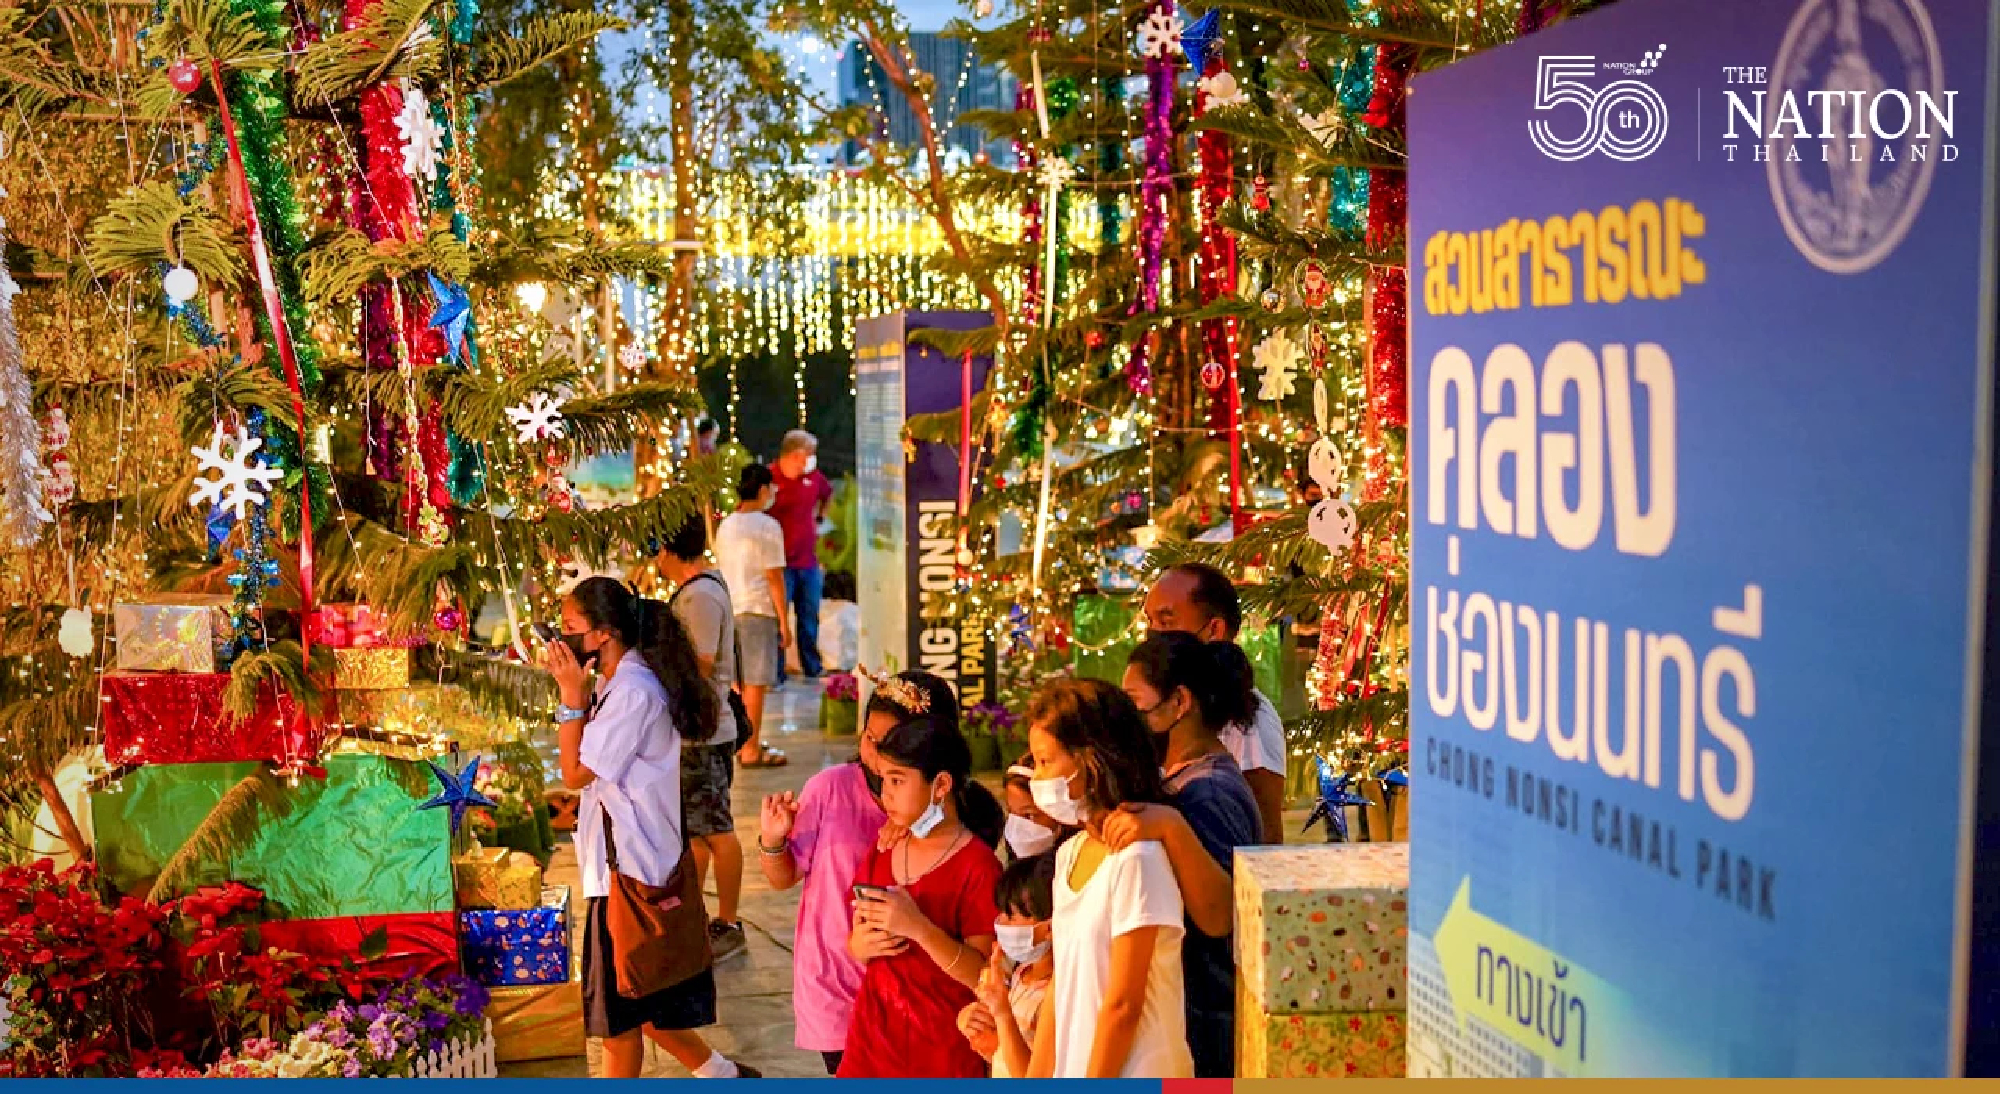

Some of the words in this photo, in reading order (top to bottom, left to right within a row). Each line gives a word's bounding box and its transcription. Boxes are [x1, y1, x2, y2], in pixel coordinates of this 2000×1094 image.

[1425, 198, 1706, 316] สวนสาธารณะ
[1428, 341, 1678, 557] คลอง
[1427, 533, 1762, 821] ช่องนนทรี
[1427, 736, 1494, 799] CHONG
[1506, 766, 1579, 835] NONSI
[1592, 799, 1681, 879] CANAL
[1697, 838, 1776, 922] PARK
[1477, 943, 1587, 1063] ทางเข้า
